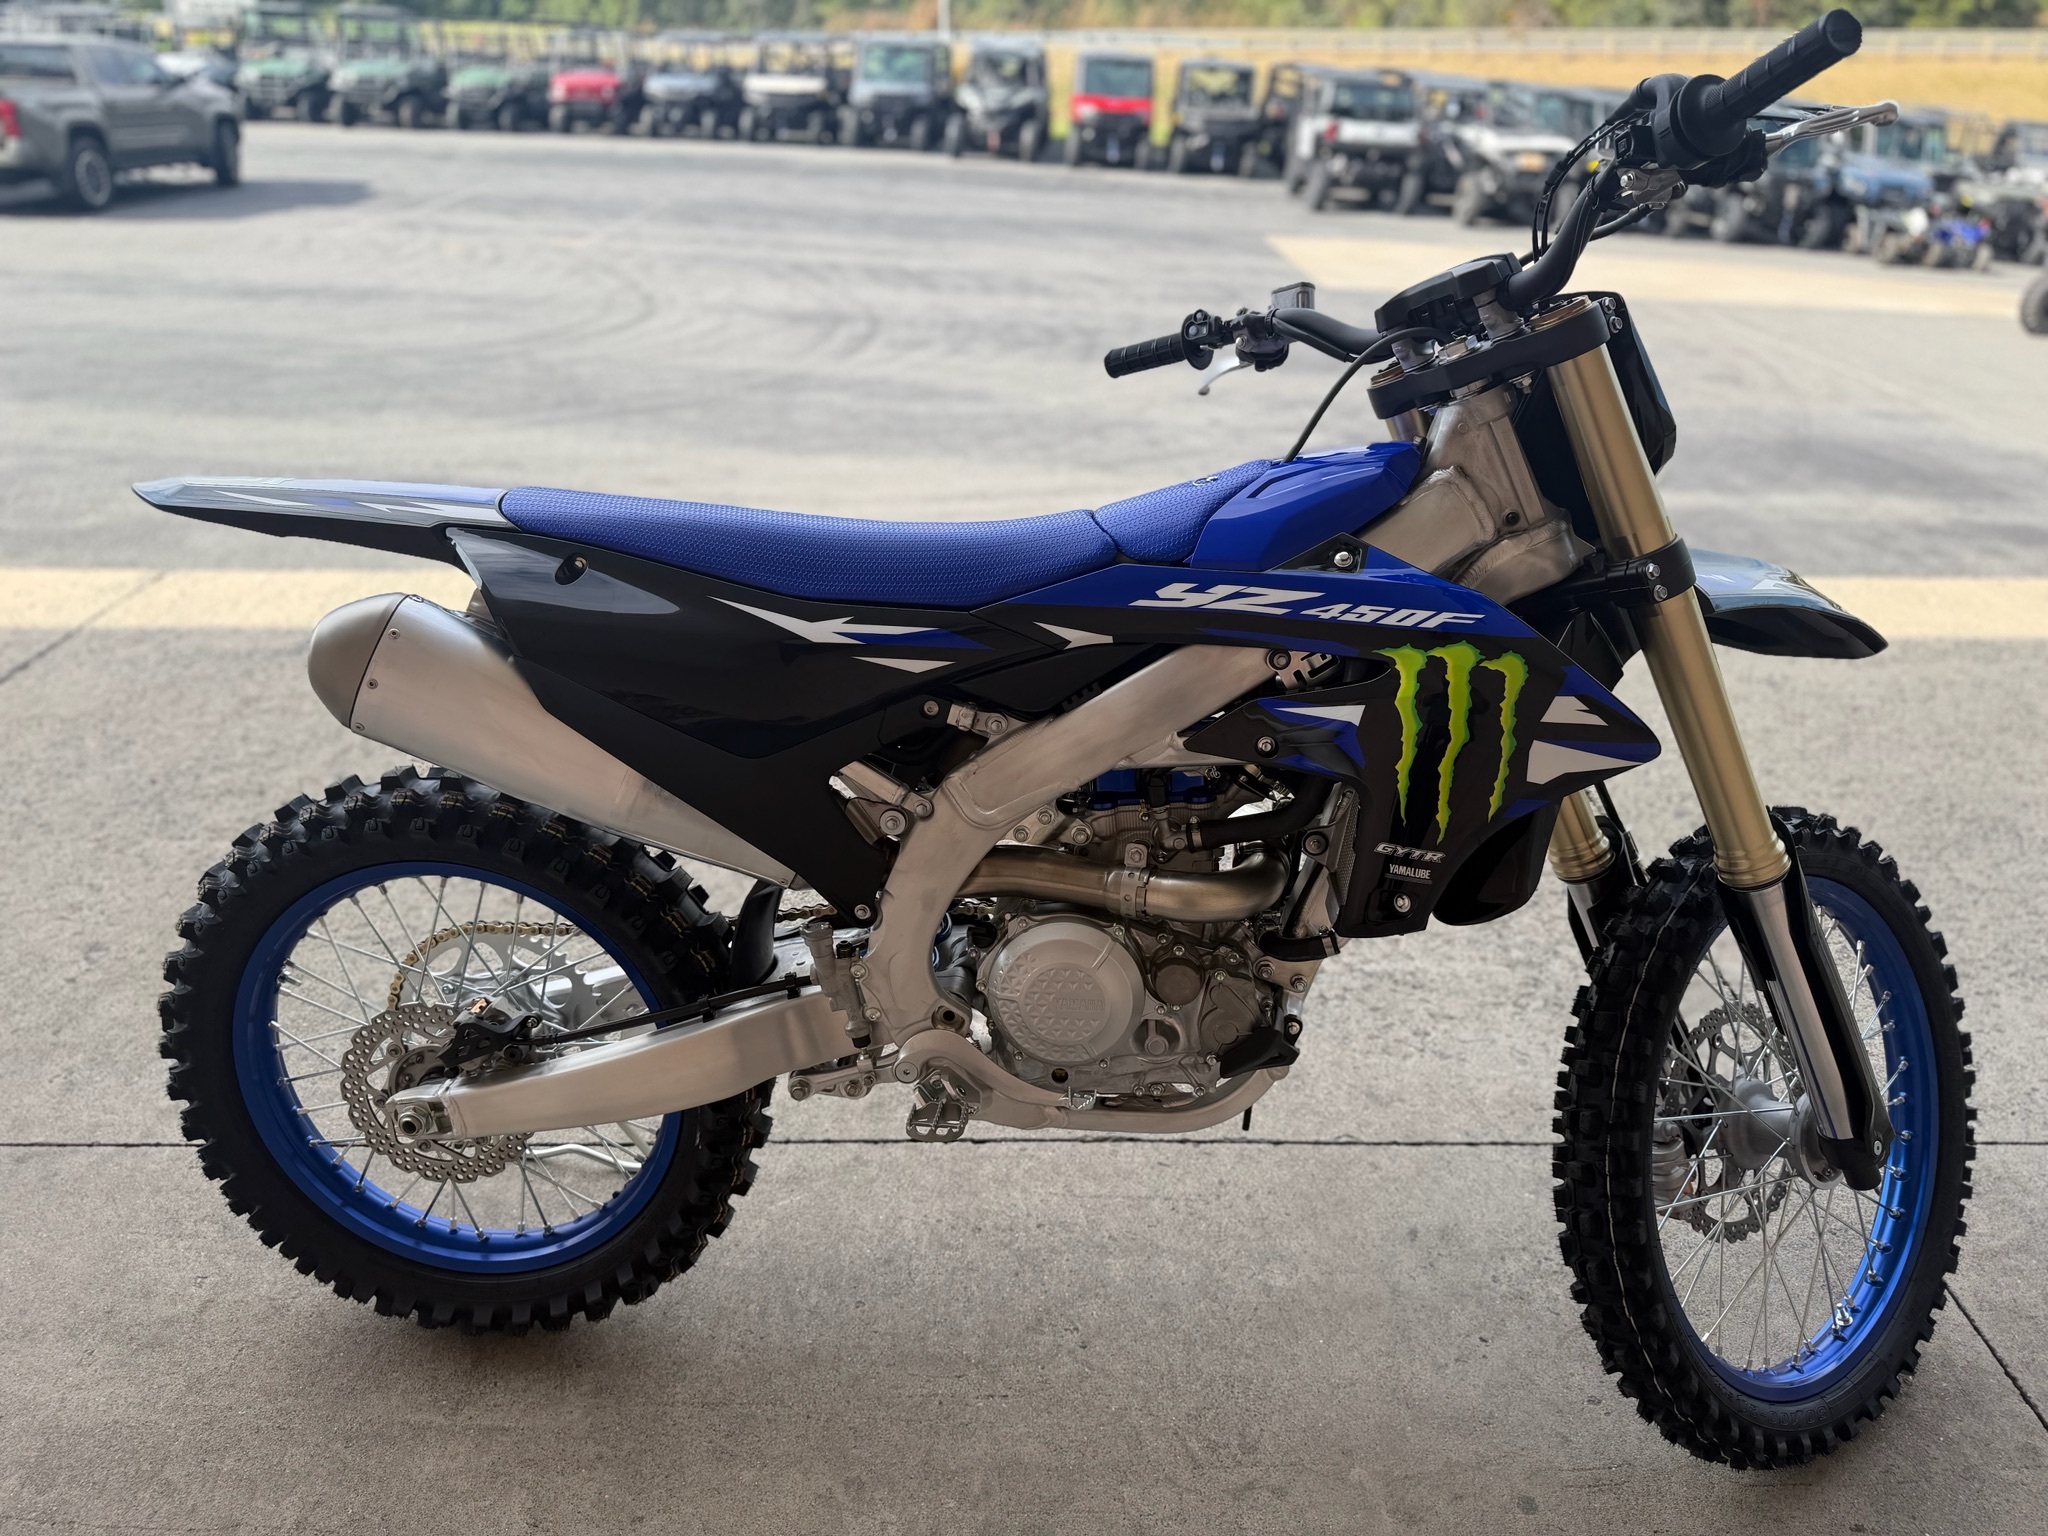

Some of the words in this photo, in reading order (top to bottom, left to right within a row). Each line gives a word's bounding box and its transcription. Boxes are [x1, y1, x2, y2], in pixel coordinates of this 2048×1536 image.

[1128, 583, 1326, 615] YZ
[1300, 603, 1486, 628] 450F
[1375, 842, 1445, 862] GYTR
[1389, 863, 1431, 879] YAMALUBE
[1054, 997, 1104, 1012] YAMAHA
